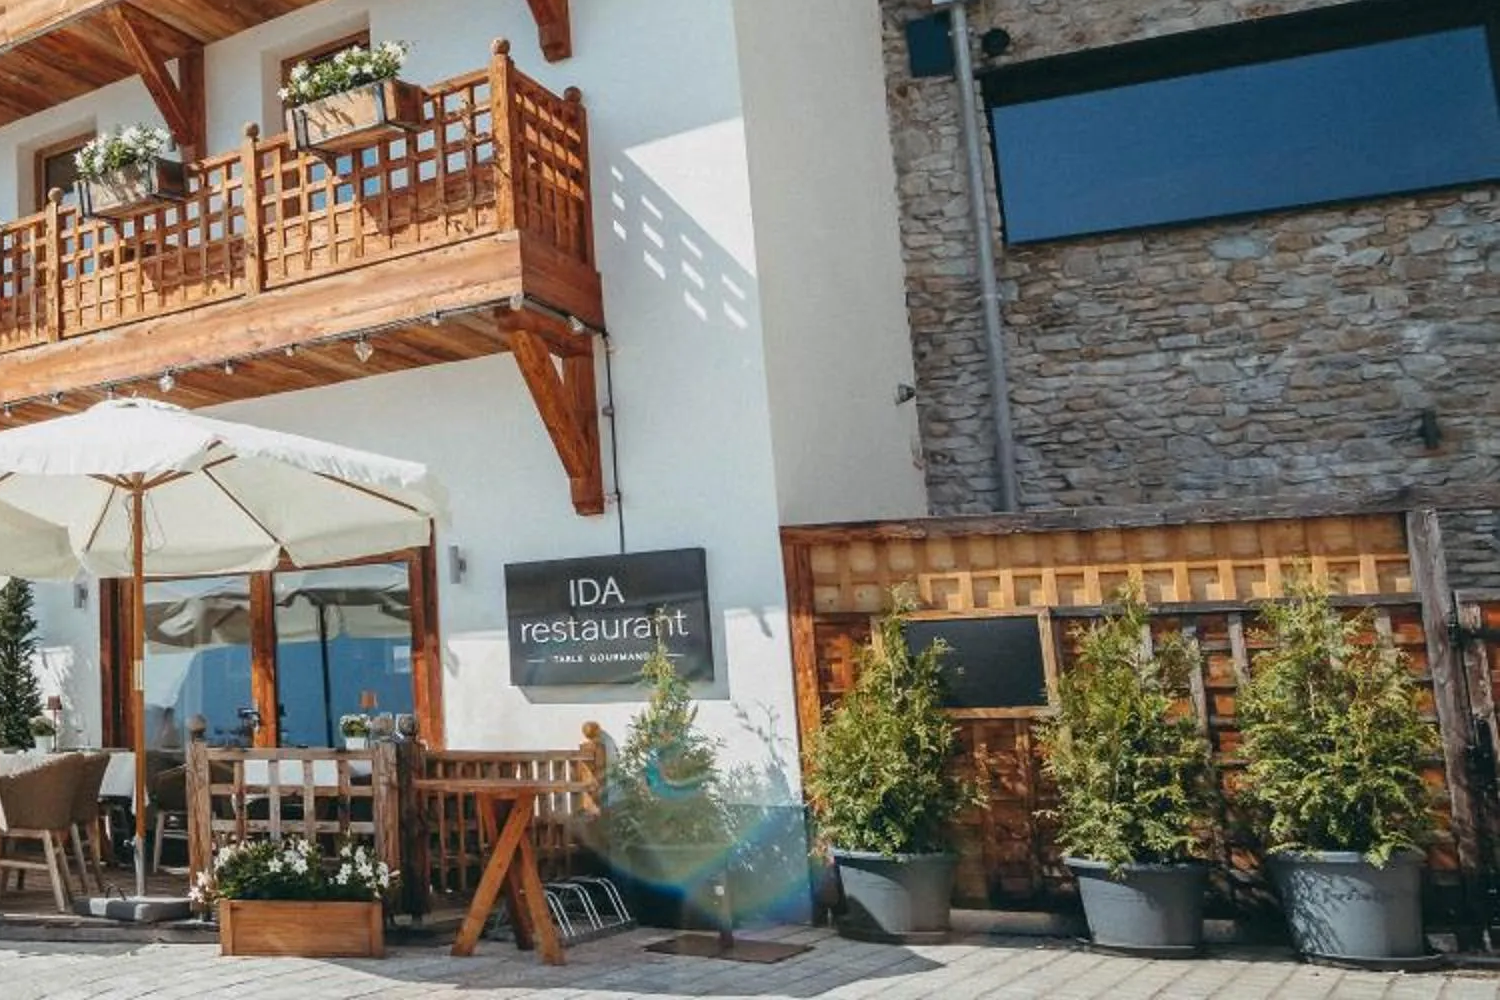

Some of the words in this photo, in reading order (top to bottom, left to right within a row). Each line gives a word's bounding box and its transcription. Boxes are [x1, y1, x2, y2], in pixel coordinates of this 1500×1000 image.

[569, 575, 626, 608] IDA
[520, 608, 690, 644] restaurant
[553, 654, 584, 664] TABLE
[589, 651, 657, 664] GOURMAND
